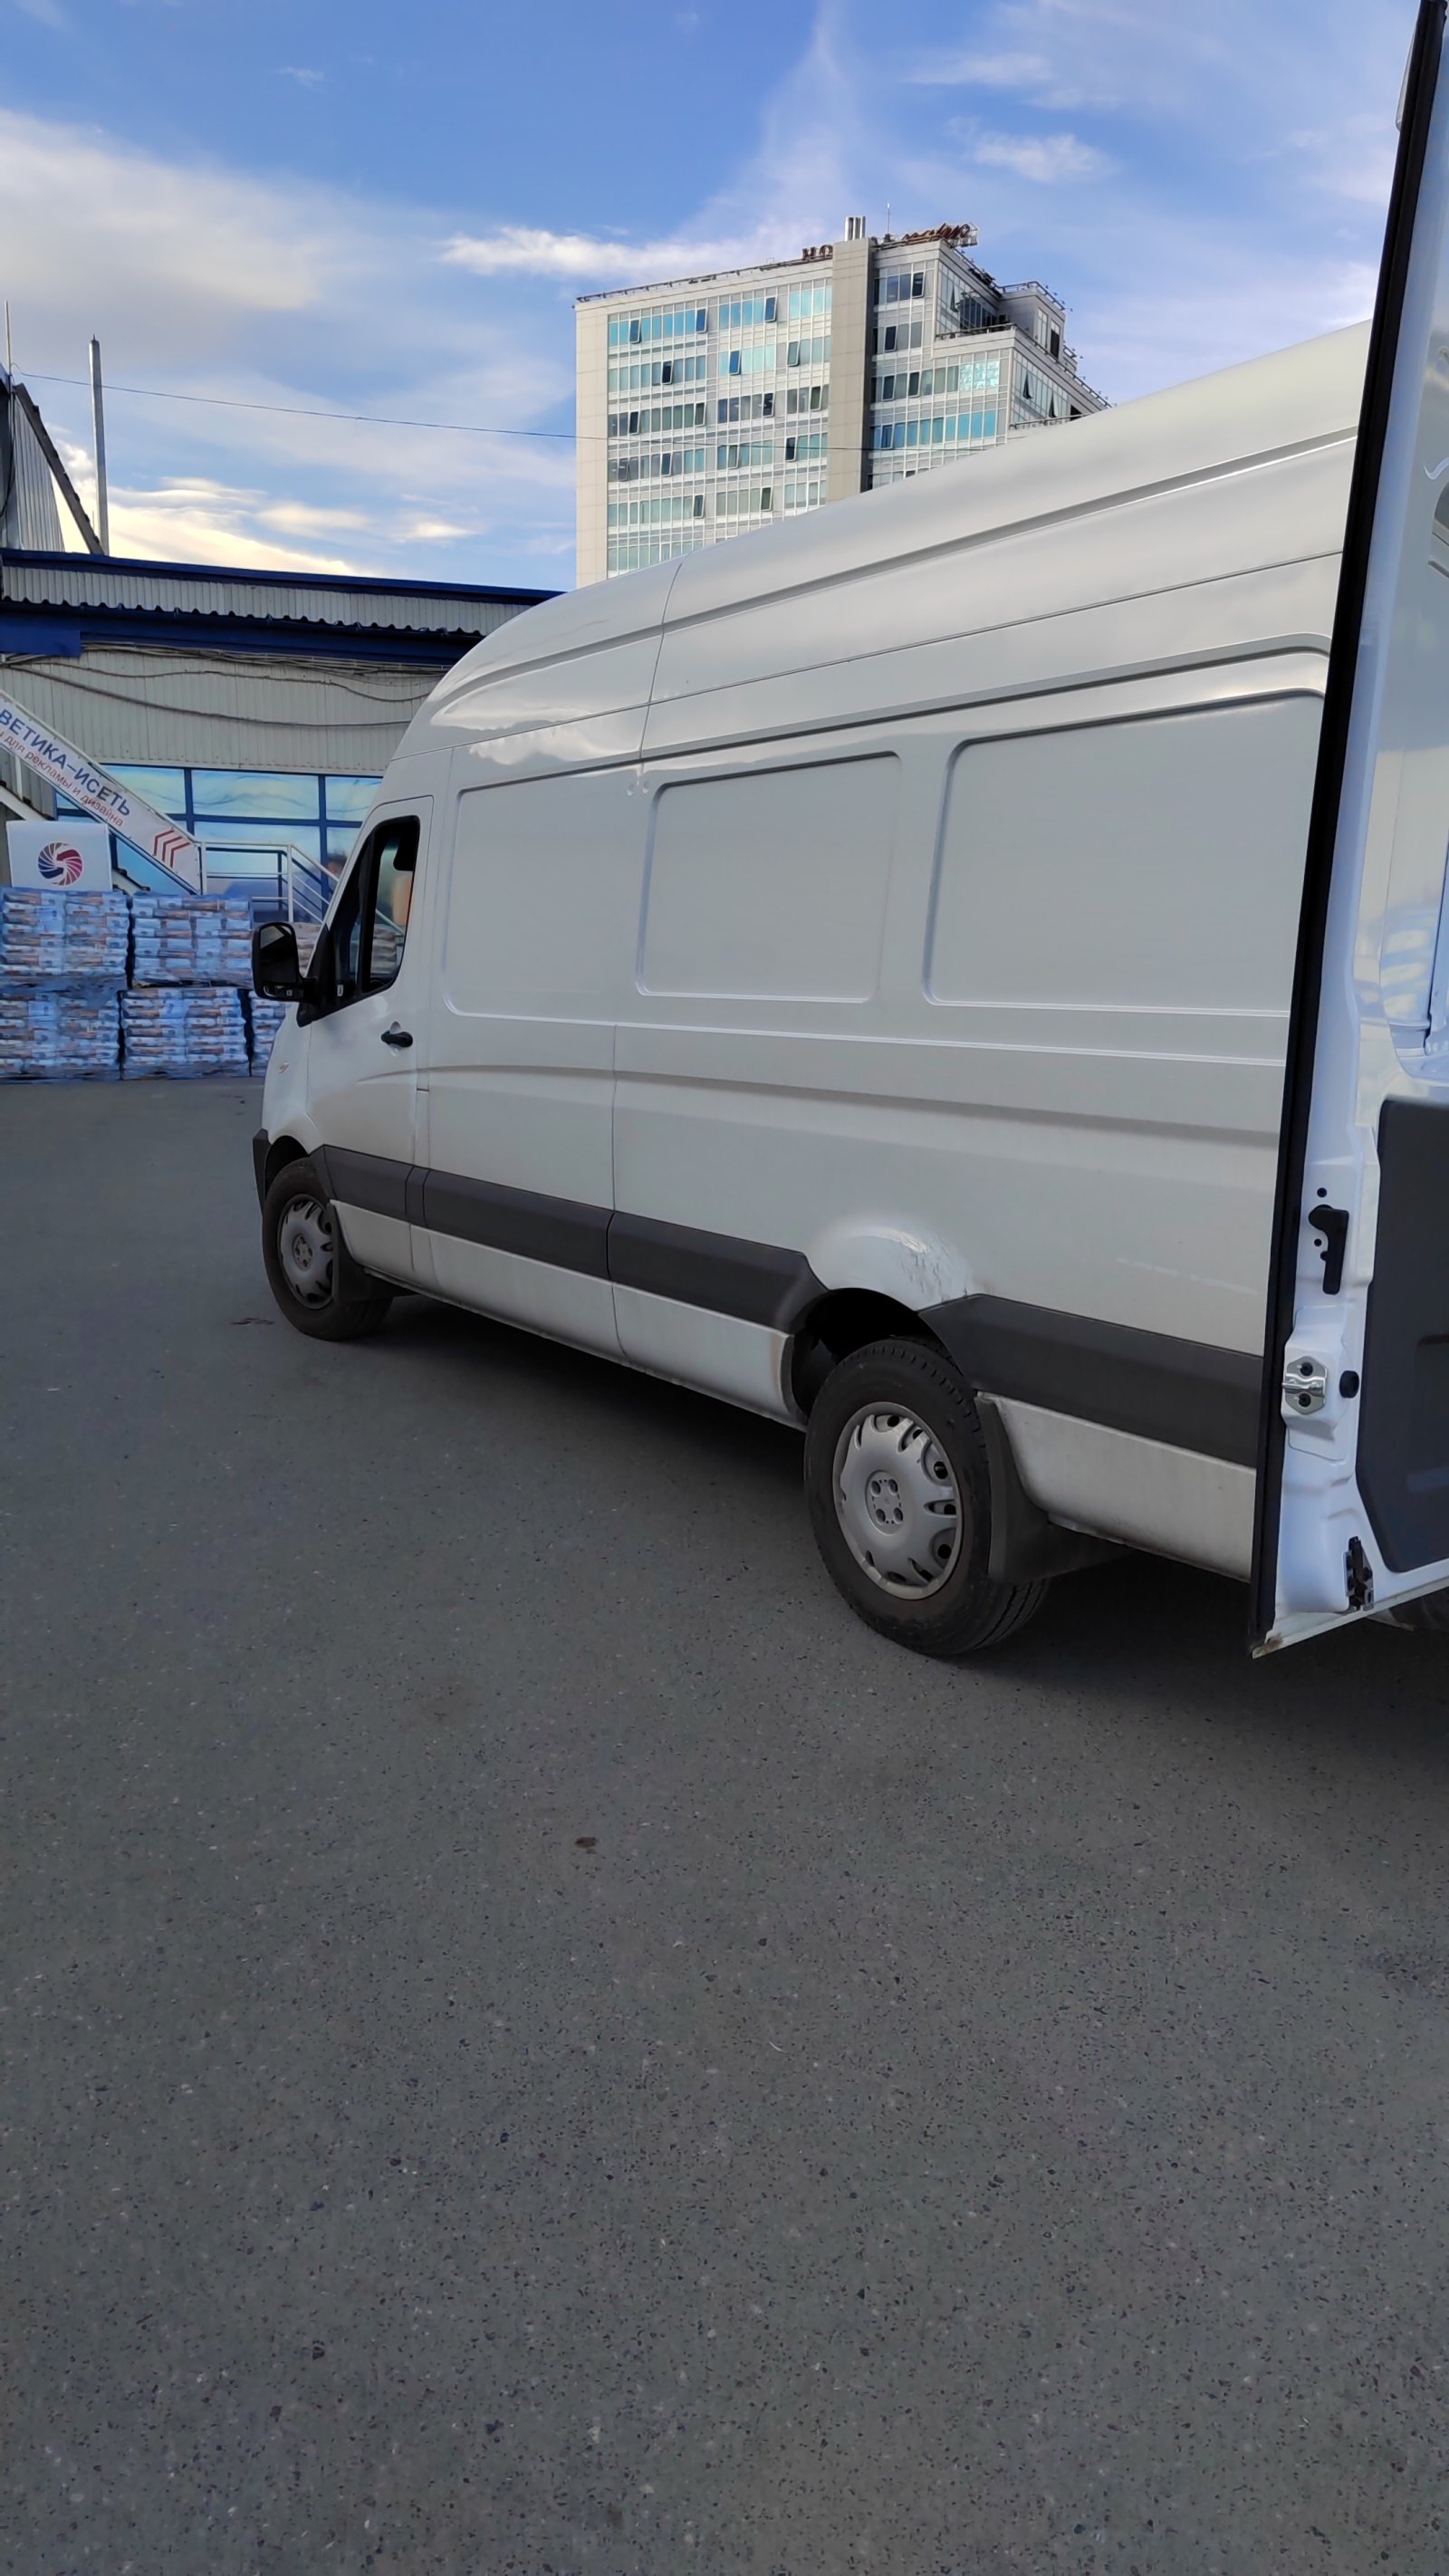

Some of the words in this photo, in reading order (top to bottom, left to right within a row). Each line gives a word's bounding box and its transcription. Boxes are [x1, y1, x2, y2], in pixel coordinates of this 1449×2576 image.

[4, 735, 25, 753] для
[25, 751, 72, 790] рекламы
[72, 786, 81, 796] и
[81, 794, 124, 828] дизайна
